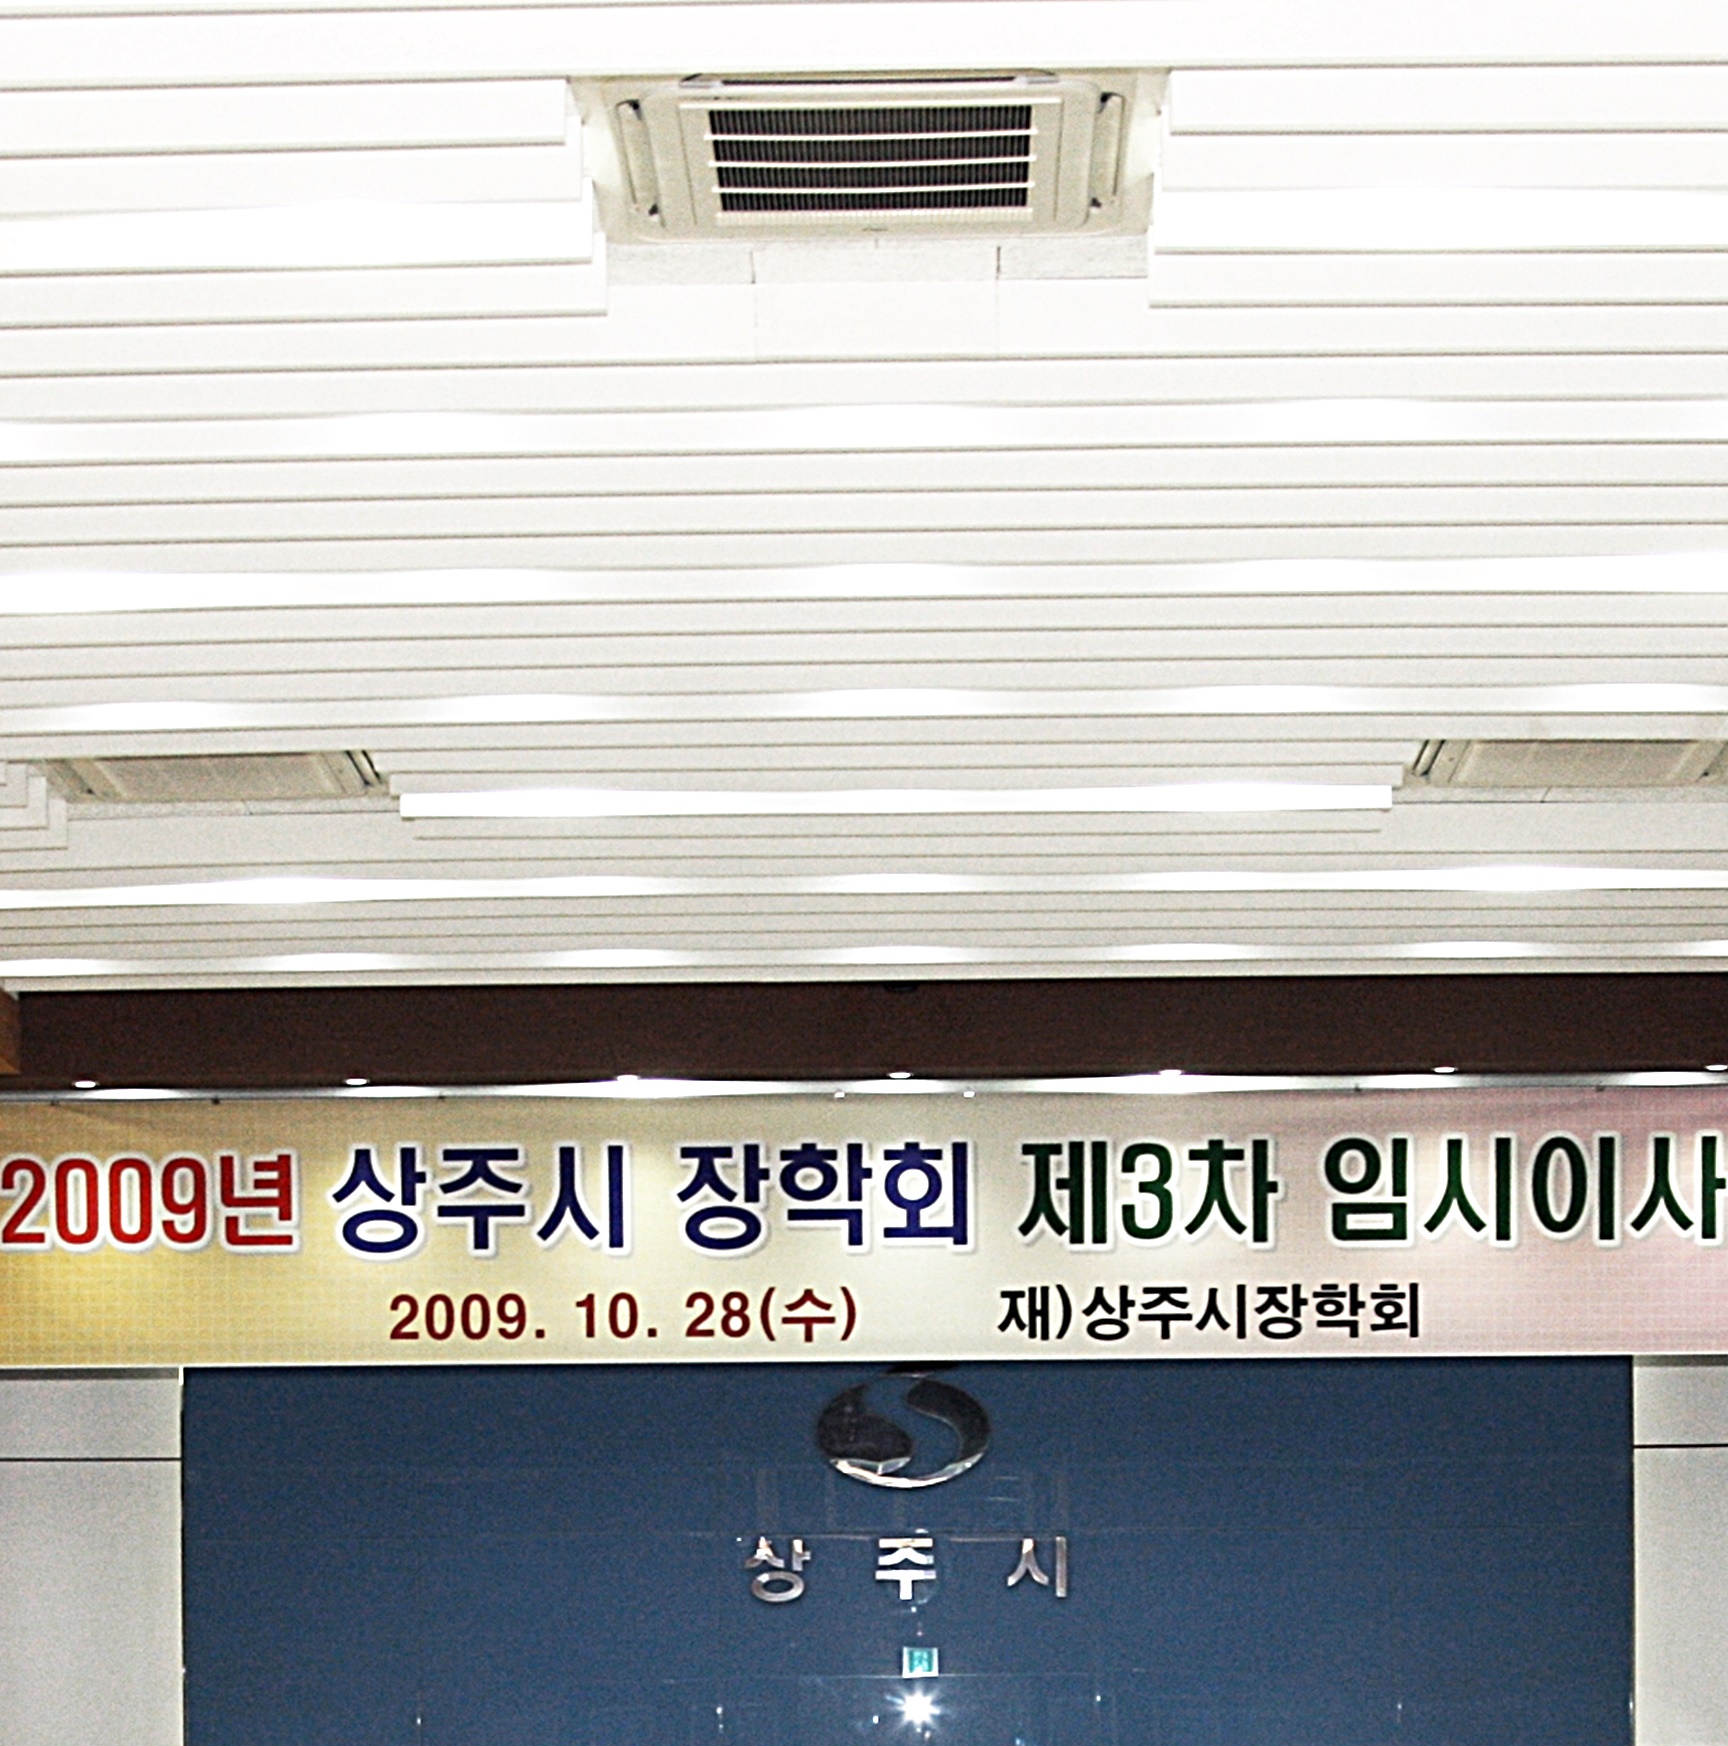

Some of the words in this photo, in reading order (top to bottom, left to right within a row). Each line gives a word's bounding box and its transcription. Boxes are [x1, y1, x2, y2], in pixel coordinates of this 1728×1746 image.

[0, 1152, 295, 1248] 2009년
[330, 1143, 626, 1255] 상주시
[675, 1140, 970, 1252] 장학회
[1016, 1137, 1280, 1247] 제3차
[389, 1292, 546, 1342] 2009.
[574, 1291, 658, 1340] 10.
[684, 1285, 857, 1344] 28(수)
[996, 1281, 1420, 1342] 재)상주시장학회
